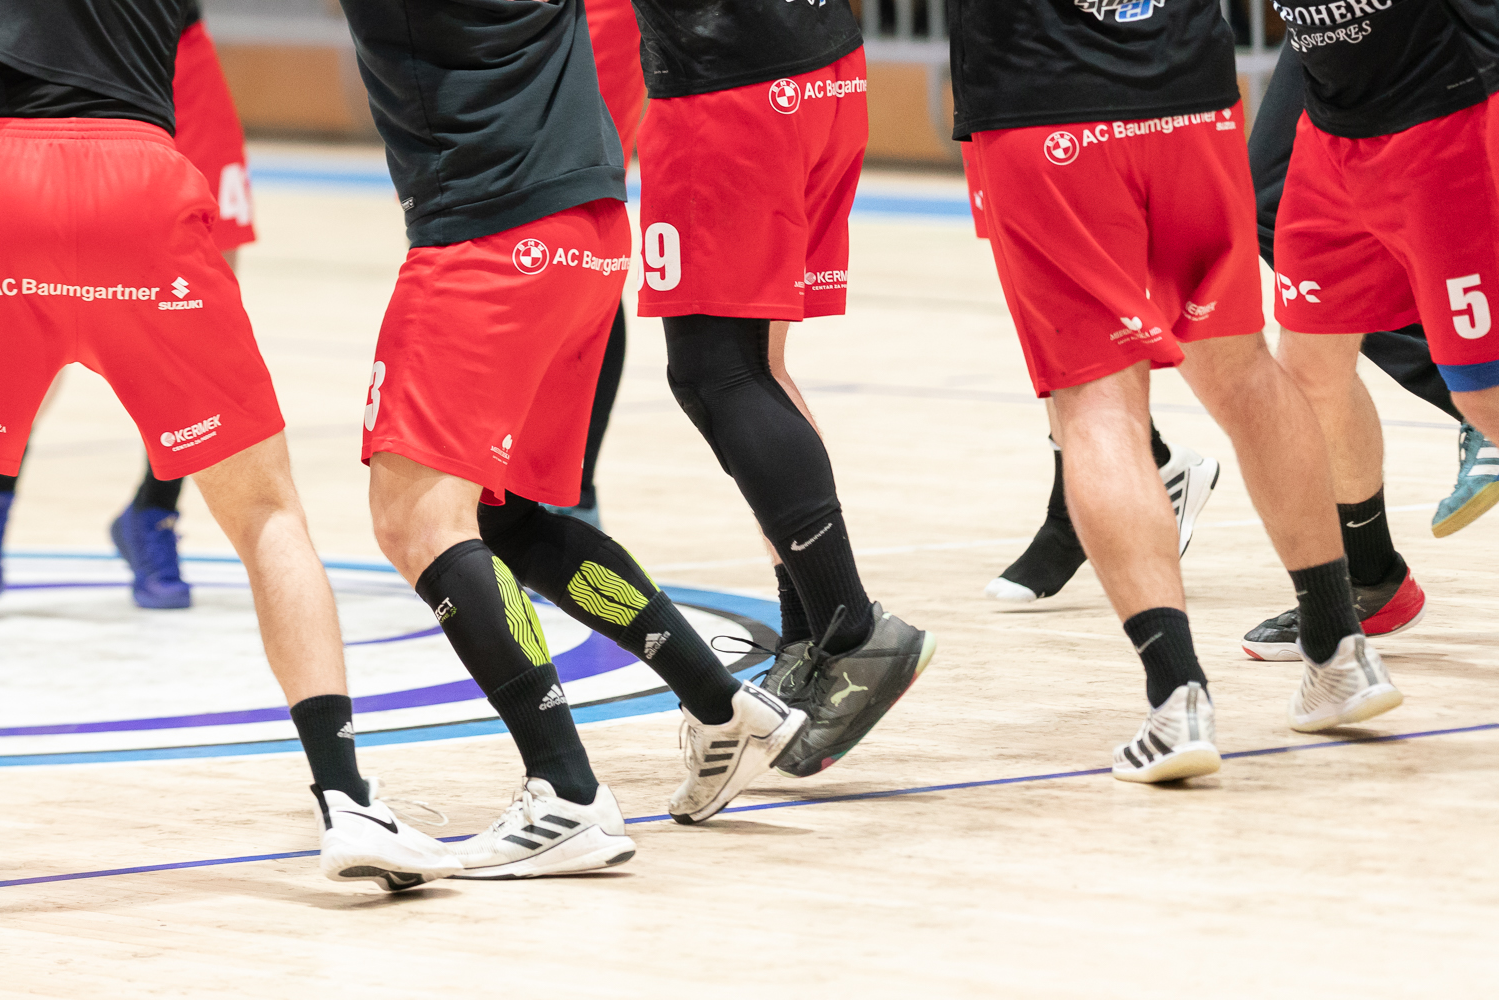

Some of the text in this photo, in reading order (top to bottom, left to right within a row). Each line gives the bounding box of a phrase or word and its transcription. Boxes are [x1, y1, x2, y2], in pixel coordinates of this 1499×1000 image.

[804, 81, 824, 99] AC
[1082, 124, 1109, 147] AC
[552, 247, 579, 267] AC
[22, 278, 160, 301] Baumgartner
[158, 299, 203, 311] SUZUKI
[1446, 273, 1491, 340] 5
[364, 361, 386, 431] 3
[174, 414, 222, 442] KERMEK
